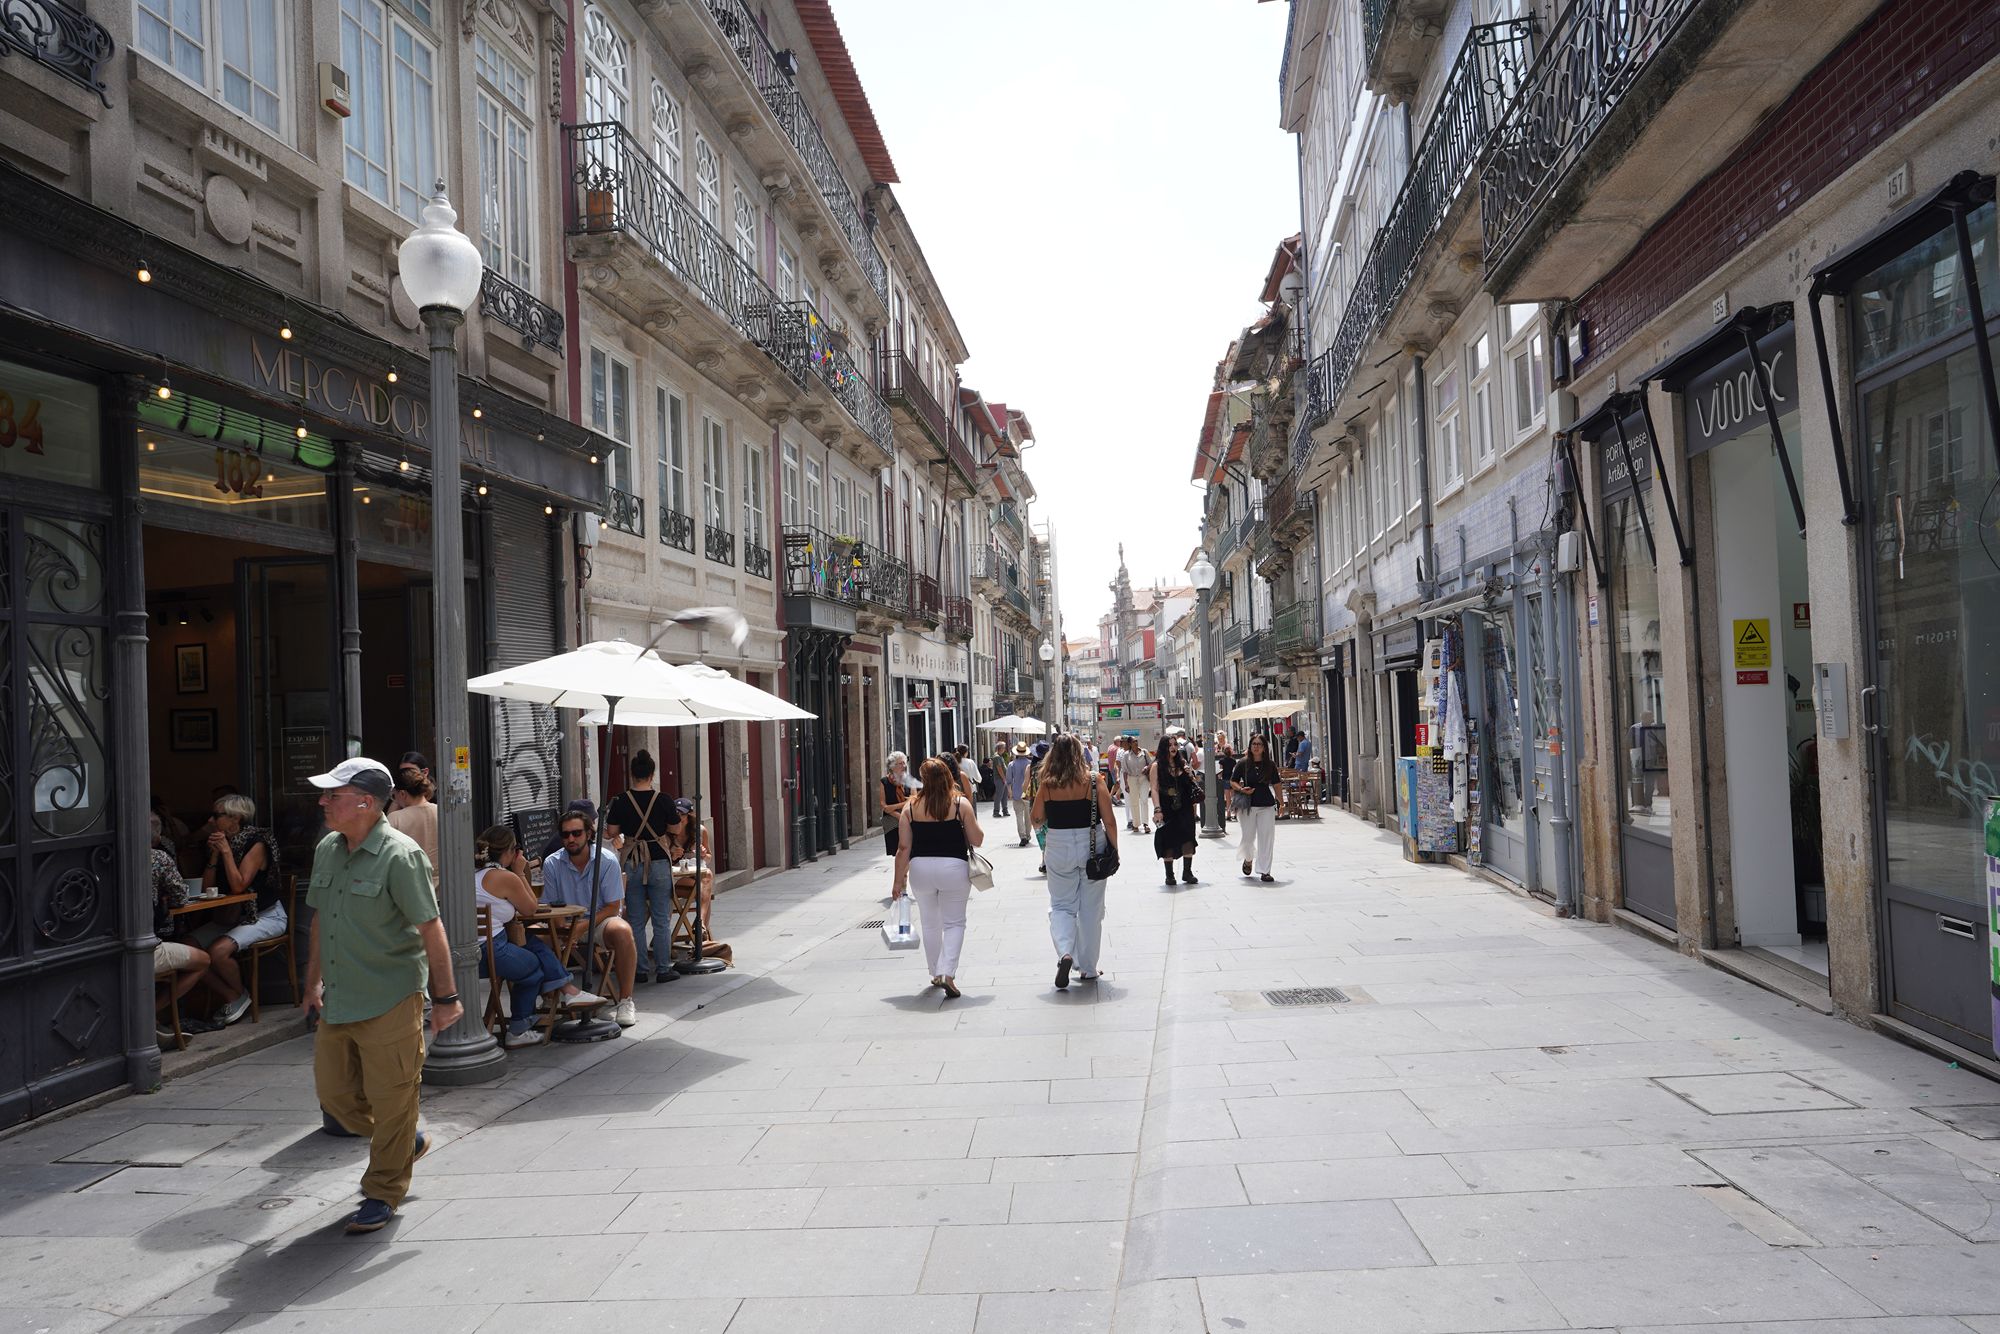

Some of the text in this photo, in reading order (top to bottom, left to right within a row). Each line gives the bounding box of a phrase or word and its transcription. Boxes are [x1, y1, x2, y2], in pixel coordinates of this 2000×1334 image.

[1888, 172, 1904, 199] 157
[1713, 300, 1724, 318] 155
[251, 335, 497, 464] MERCADOR AFE
[214, 446, 264, 499] 182
